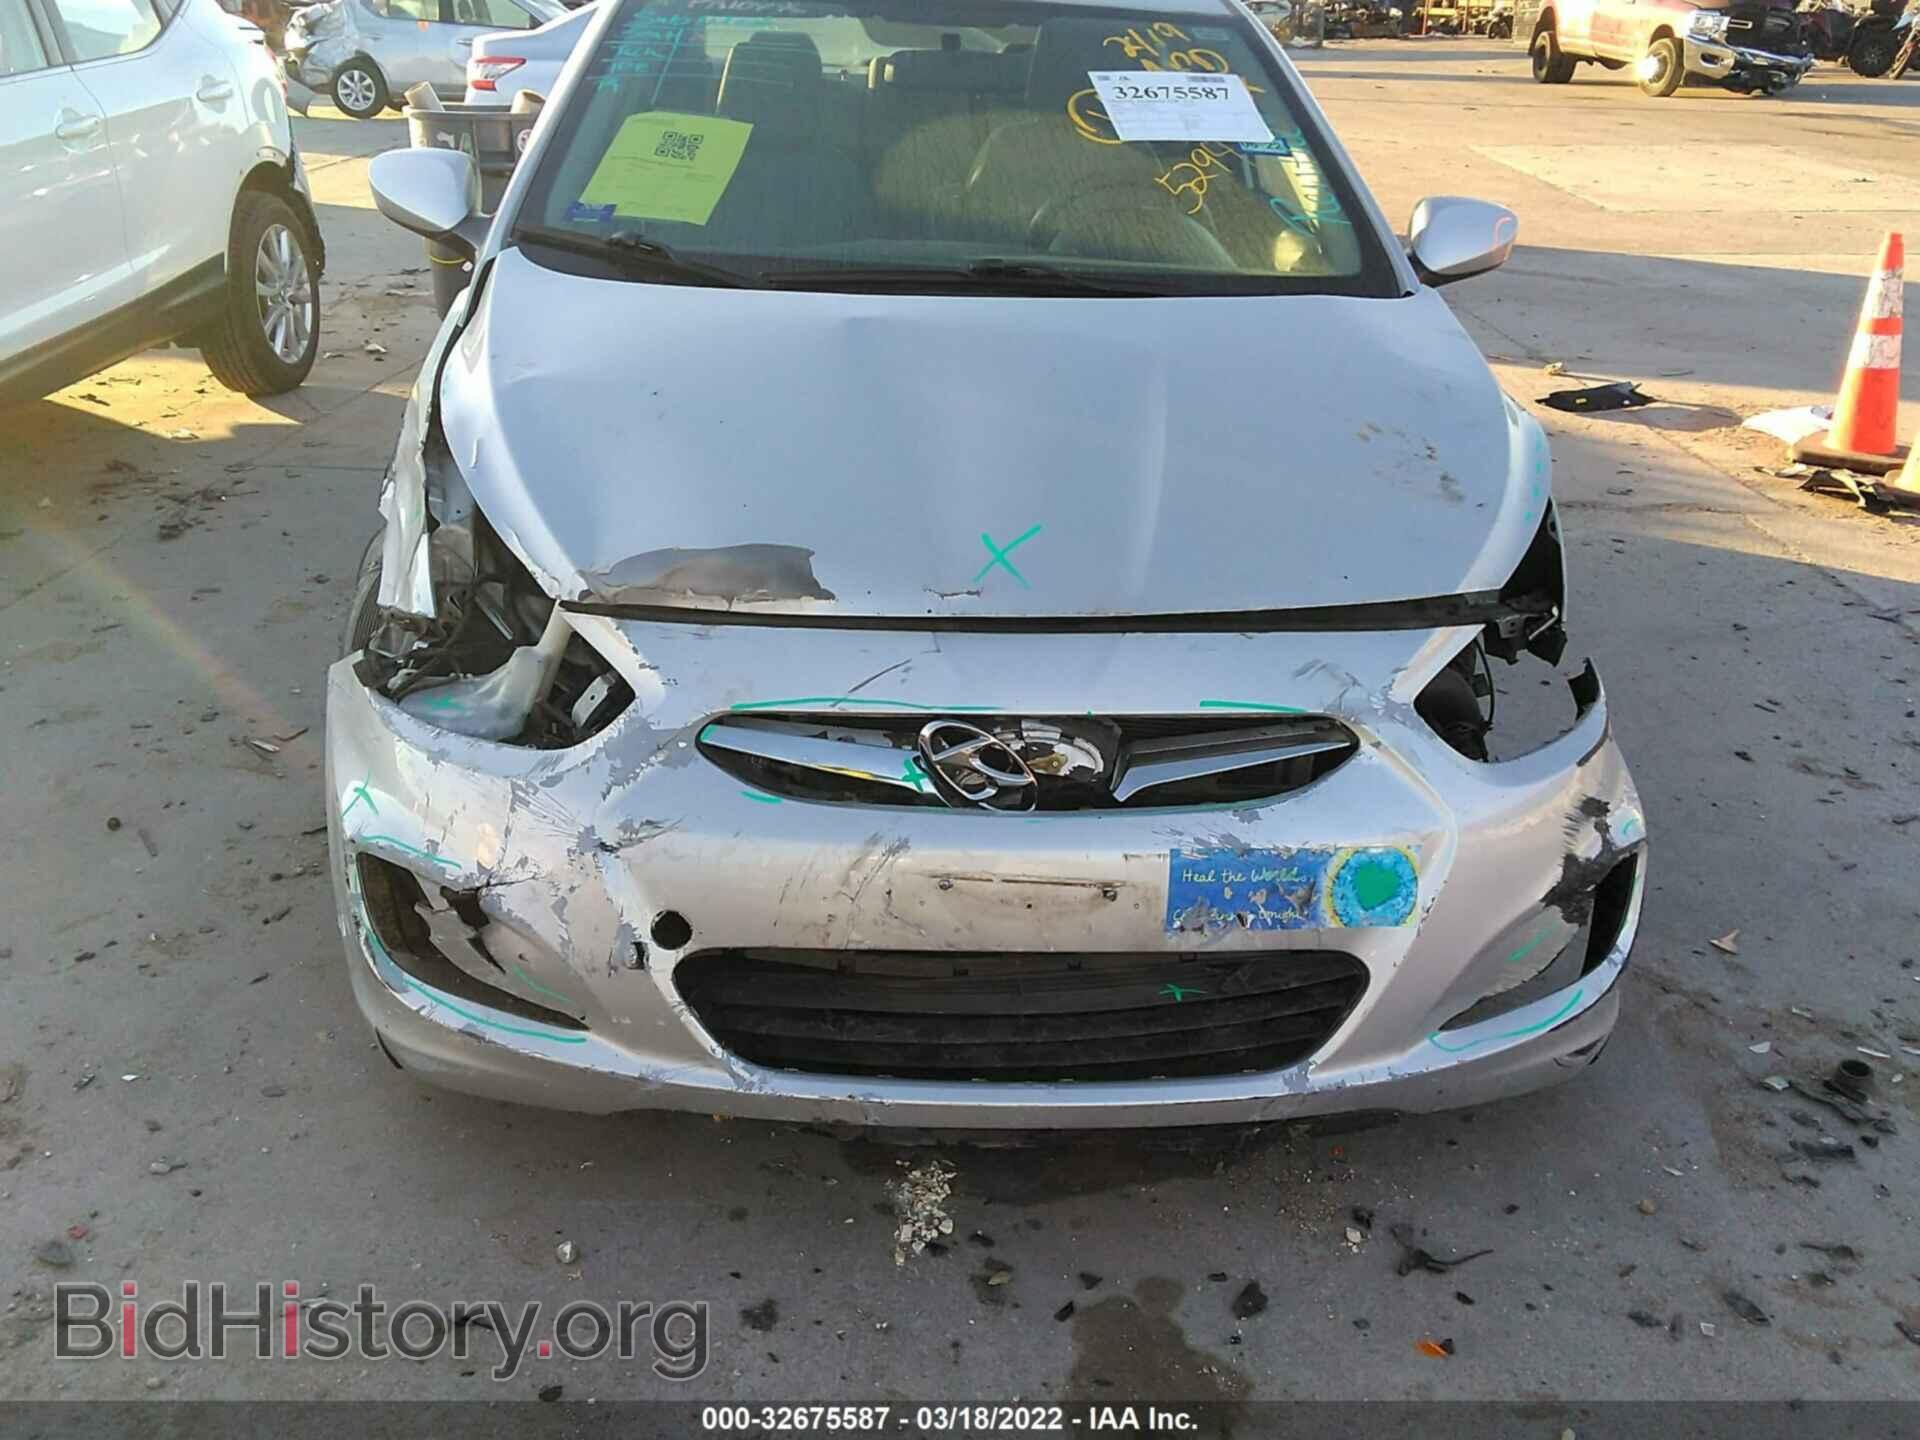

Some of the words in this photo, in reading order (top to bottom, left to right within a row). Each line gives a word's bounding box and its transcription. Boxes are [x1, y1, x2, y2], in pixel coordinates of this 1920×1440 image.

[1112, 86, 1229, 100] 32675587
[1182, 868, 1216, 882] Heal
[1221, 868, 1246, 882] the
